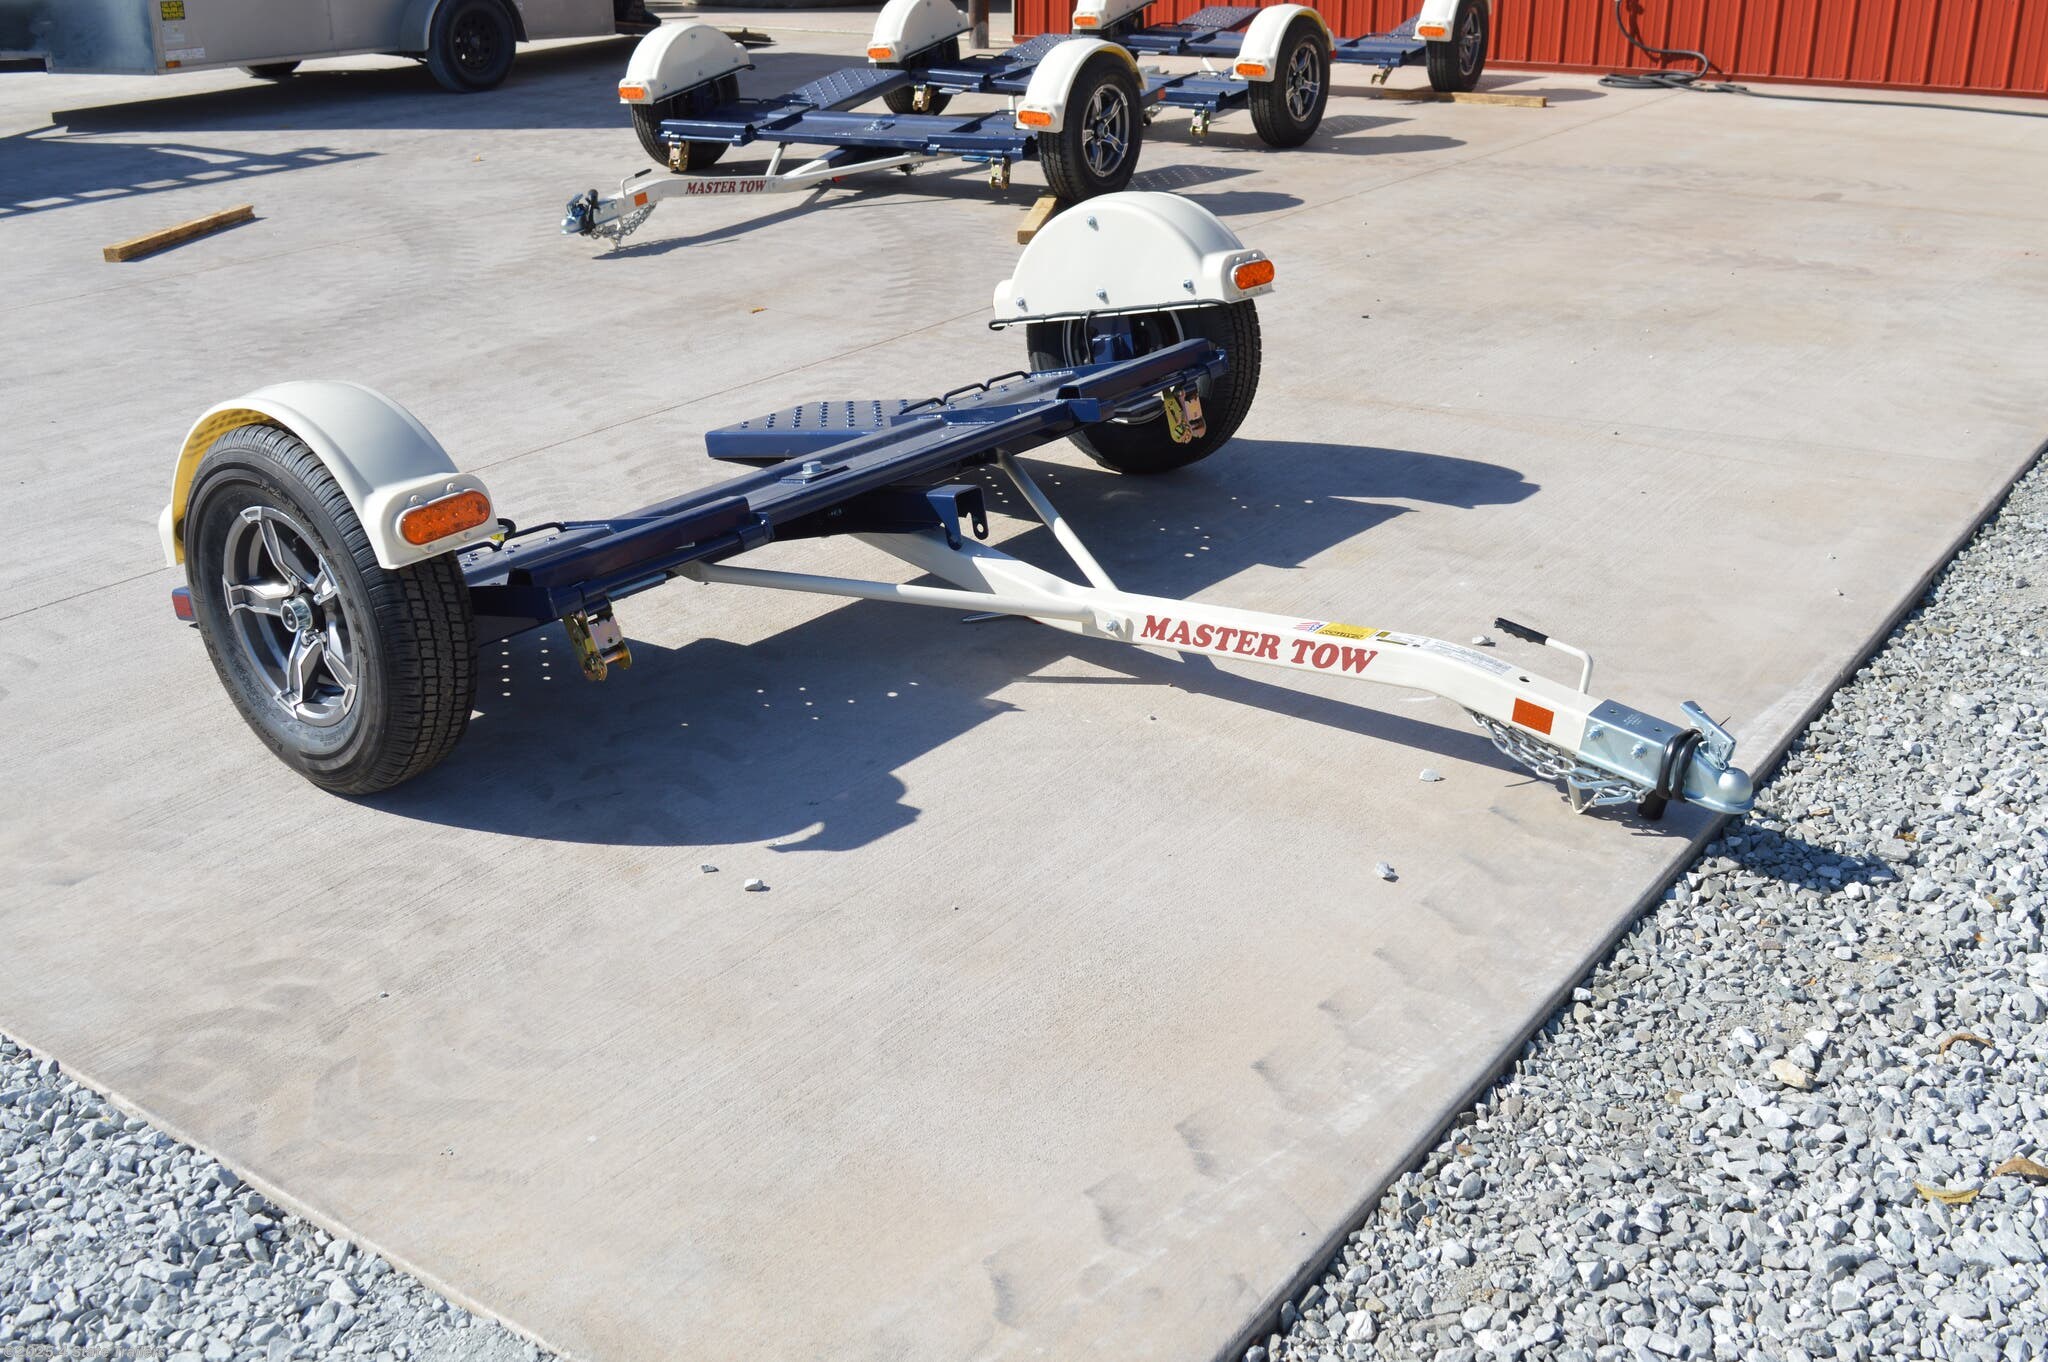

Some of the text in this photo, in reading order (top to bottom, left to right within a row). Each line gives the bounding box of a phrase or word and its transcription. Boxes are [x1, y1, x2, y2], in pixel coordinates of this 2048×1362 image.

[685, 180, 767, 194] MASTER TOW
[1140, 614, 1281, 660] MASTER
[1291, 639, 1378, 674] TOW
